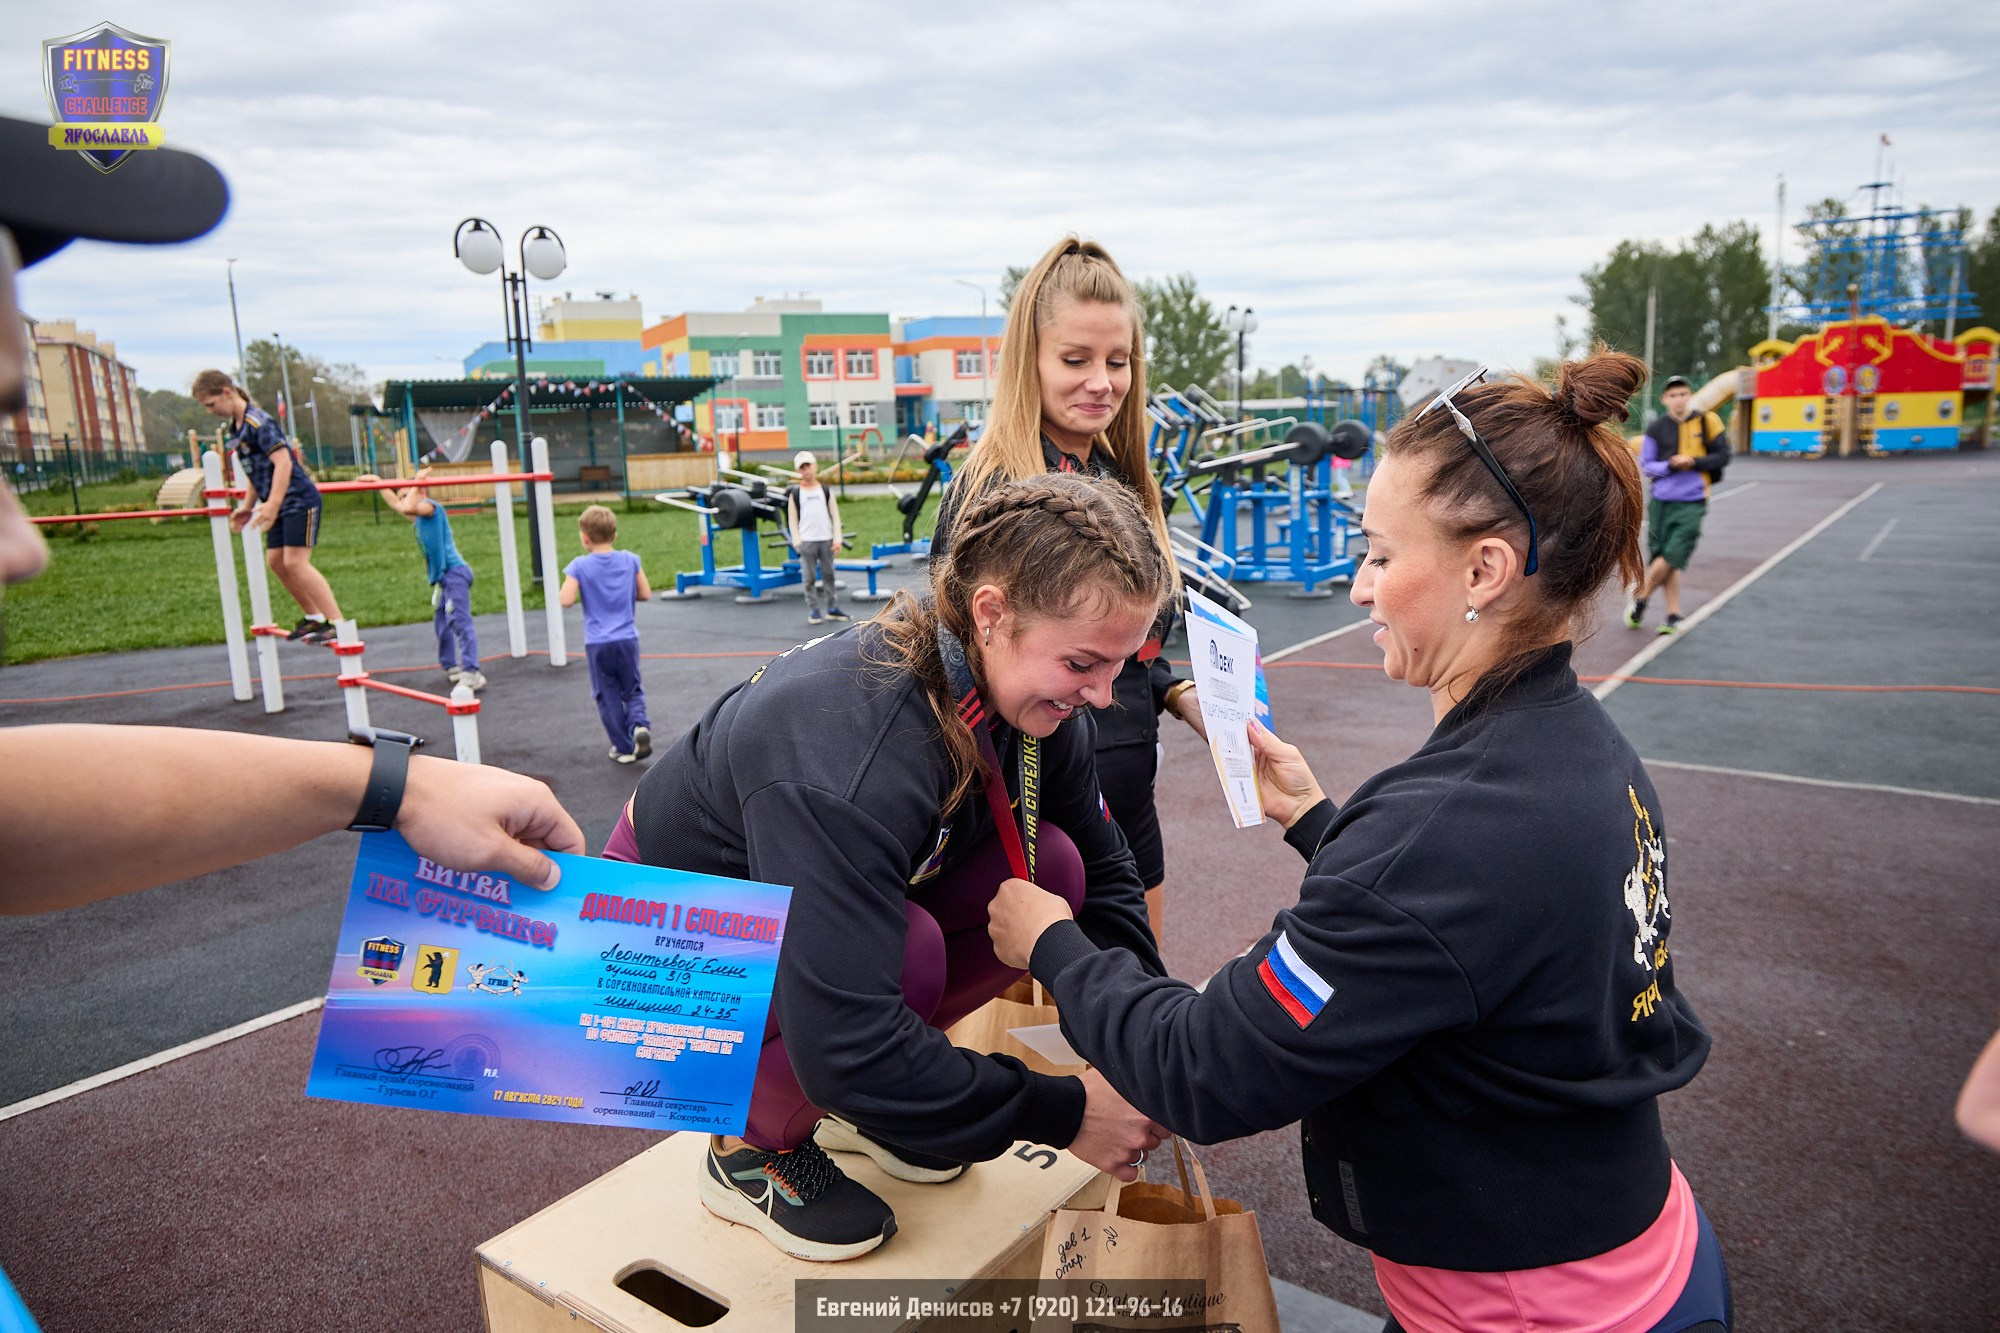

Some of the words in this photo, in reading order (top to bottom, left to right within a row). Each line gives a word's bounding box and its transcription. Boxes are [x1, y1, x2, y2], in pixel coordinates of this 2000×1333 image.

[1023, 733, 1038, 811] СТРЕЛКЕ
[1027, 815, 1037, 839] НА
[415, 856, 512, 905] БИТВА
[365, 872, 410, 907] НА
[416, 888, 558, 948] СТРЕЛКЕ!
[579, 892, 667, 928] ДИПЛОМ
[672, 904, 681, 929] 1
[685, 906, 779, 942] СТЕПЕНИ
[368, 942, 400, 954] FITNESS
[655, 935, 704, 951] ВРУЧАЕТСЯ
[488, 978, 508, 987] IFBB
[598, 977, 603, 988] В
[605, 978, 691, 997] СОРЕВНОВАТЕЛЬНОЙ
[693, 990, 741, 1005] КАТЕГОРИИ
[579, 1013, 592, 1027] НА
[618, 1017, 645, 1032] КУБКЕ
[646, 1020, 704, 1038] ЯРОСЛАВСКОЙ
[705, 1027, 744, 1043] ОБЛАСТИ
[586, 1028, 598, 1040] ПО
[720, 1042, 733, 1055] НА
[334, 1067, 377, 1082] Главный
[408, 1078, 475, 1092] соревнований
[378, 1085, 416, 1099] Гурьева
[493, 1090, 503, 1101] 17
[503, 1090, 541, 1105] АВГУСТА
[542, 1093, 562, 1107] 2024
[593, 1106, 656, 1120] соревнований
[669, 1111, 711, 1124] Кокорева
[713, 1115, 732, 1126] А.С.
[624, 1097, 663, 1109] Главный
[665, 1102, 708, 1114] секретарь
[1081, 1227, 1092, 1241] 1
